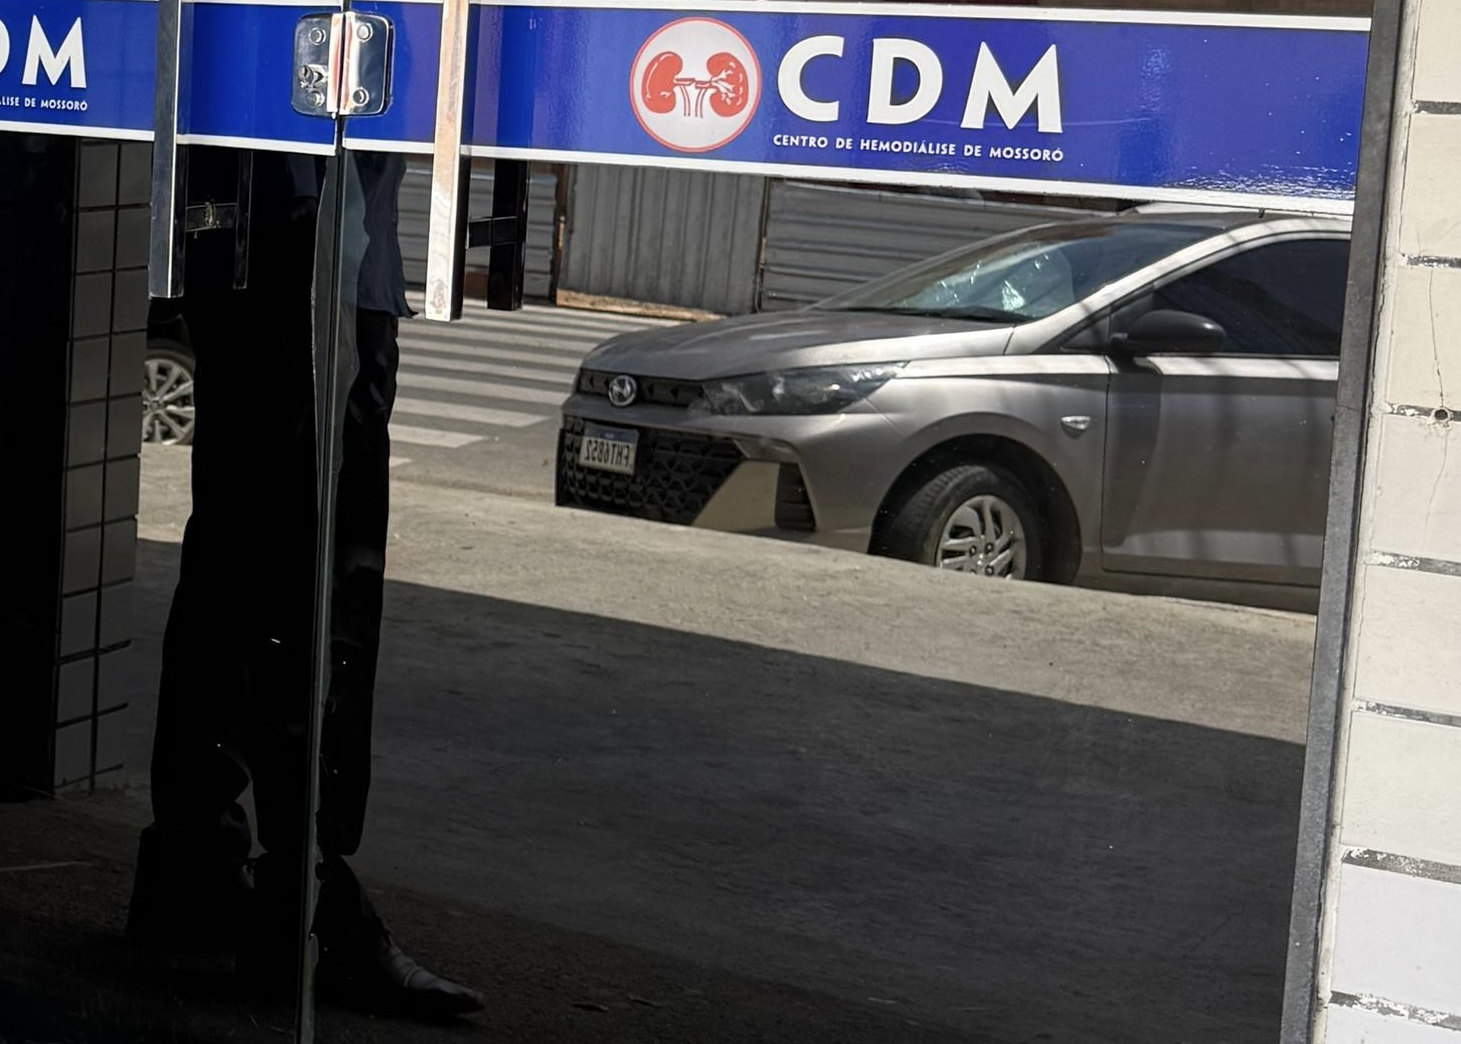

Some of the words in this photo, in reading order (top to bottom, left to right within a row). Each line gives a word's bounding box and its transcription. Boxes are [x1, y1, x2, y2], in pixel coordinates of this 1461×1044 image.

[777, 35, 1064, 134] CDM
[24, 97, 36, 108] DE
[773, 134, 829, 149] CENTRO
[835, 137, 853, 150] DE
[859, 138, 956, 156] HEMODIÁLISE
[963, 144, 982, 157] DE
[989, 146, 1064, 162] MOSSORÓ
